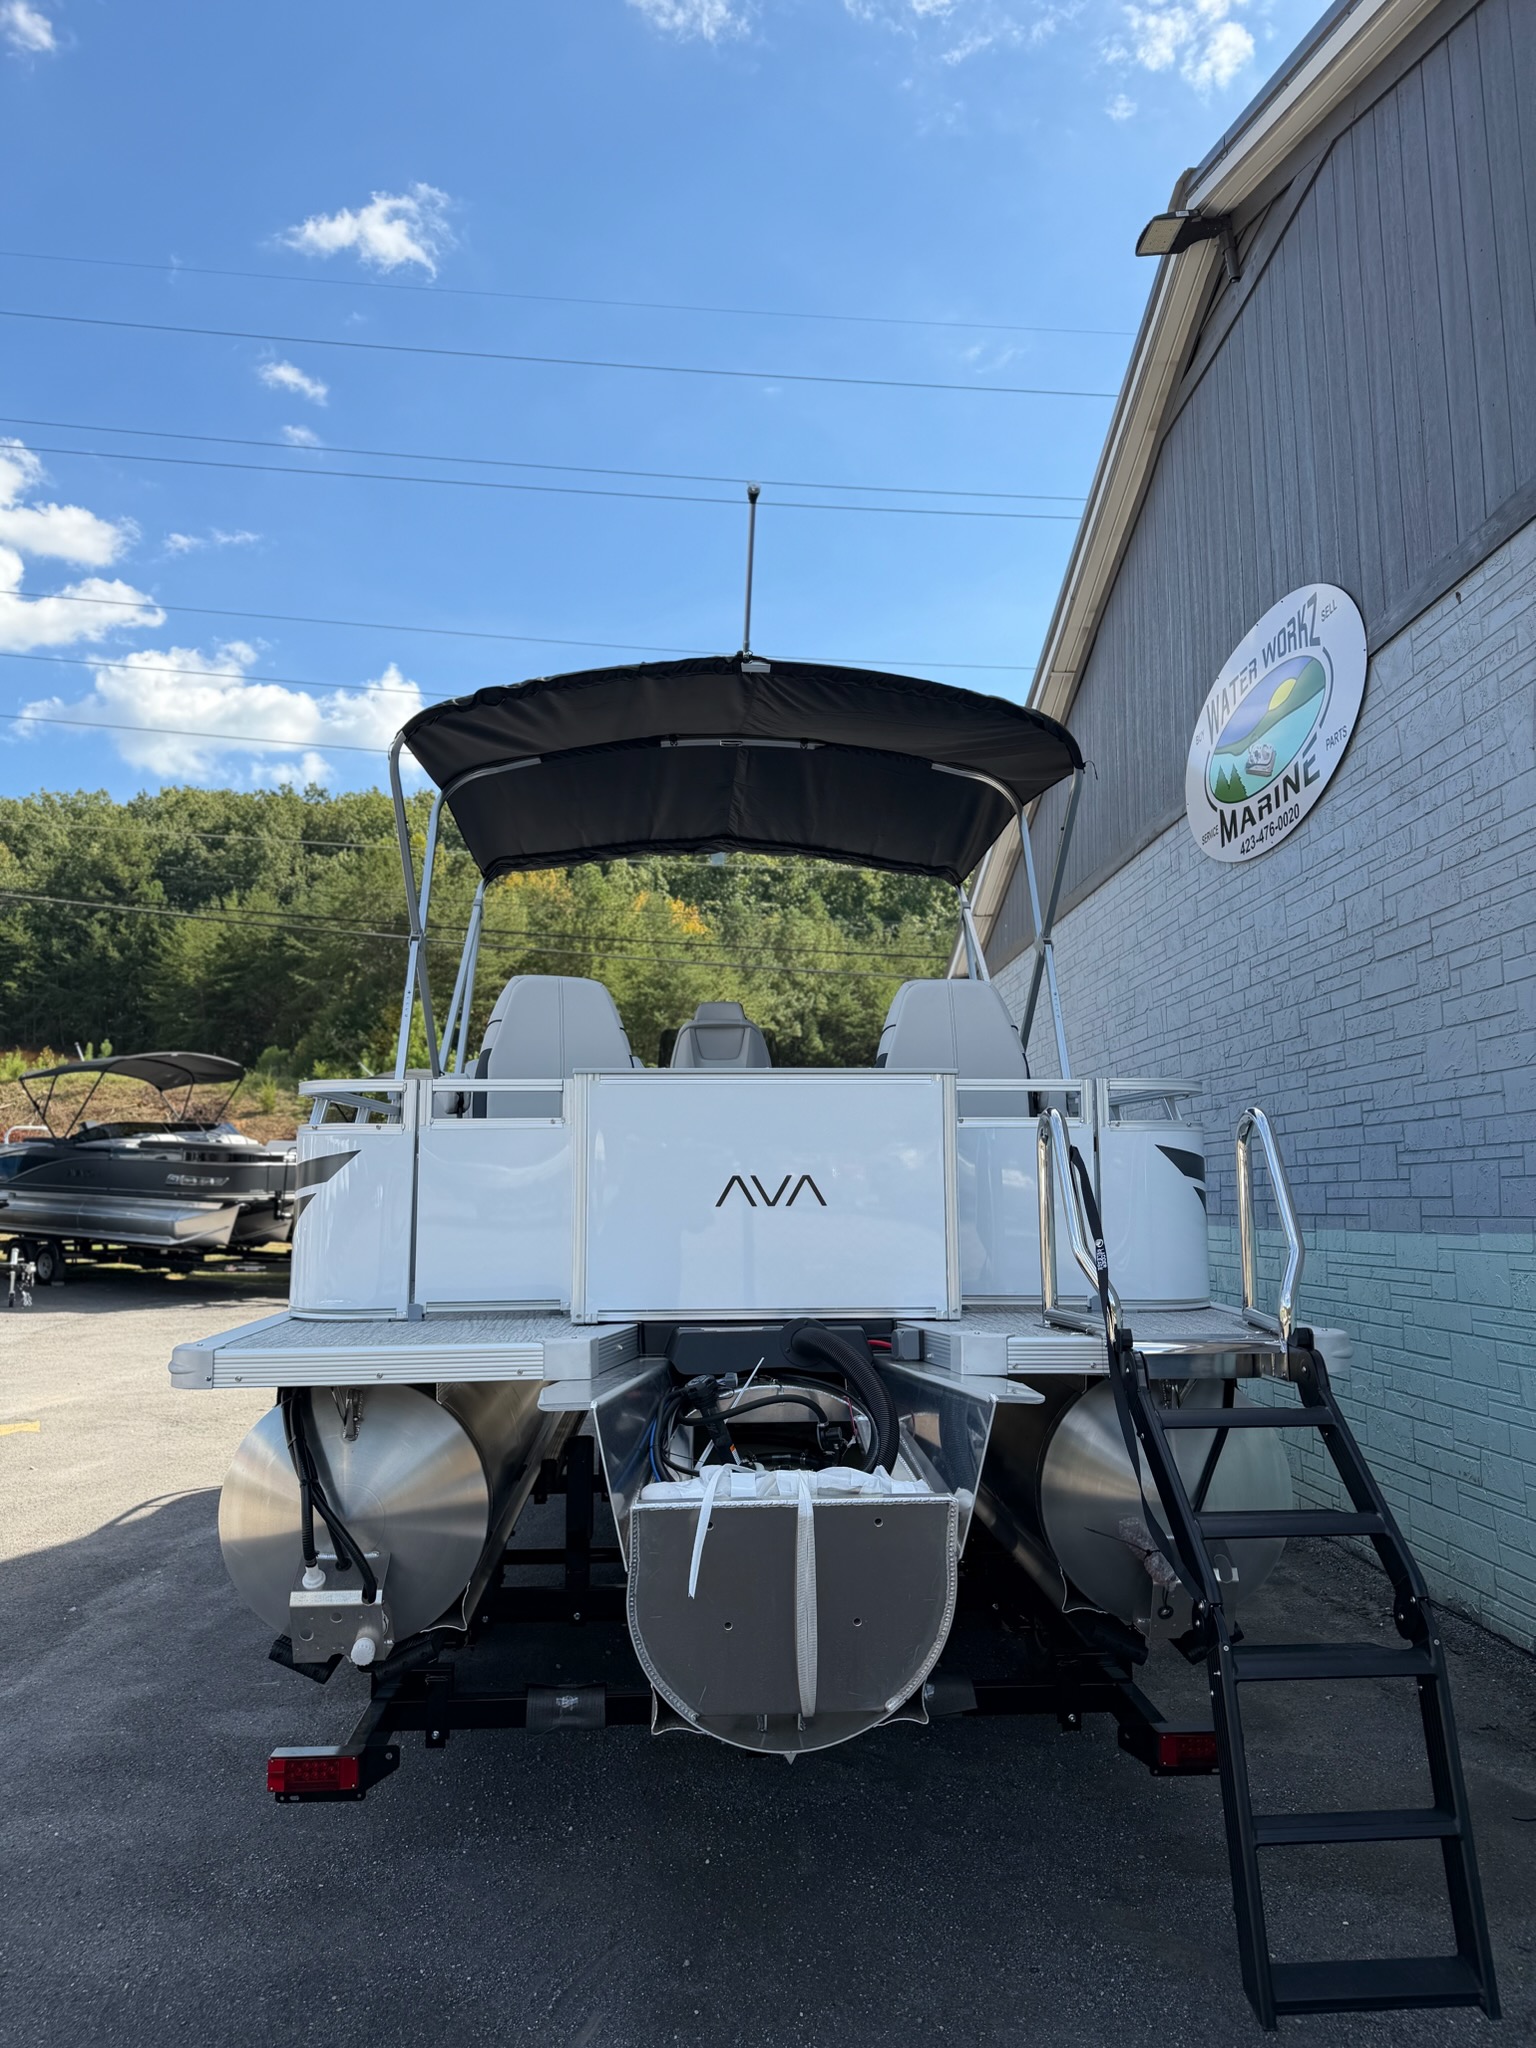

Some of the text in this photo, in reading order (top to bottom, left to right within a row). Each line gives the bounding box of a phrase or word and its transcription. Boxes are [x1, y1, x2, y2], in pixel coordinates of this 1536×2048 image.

[1321, 600, 1338, 622] SELL
[1206, 592, 1321, 746] WATER WORKZ
[1325, 725, 1348, 751] PARTS
[1219, 732, 1320, 848] MARINE
[1201, 824, 1219, 845] SERVICE
[1240, 803, 1300, 855] 423-476-0020
[715, 1175, 827, 1207] AVA
